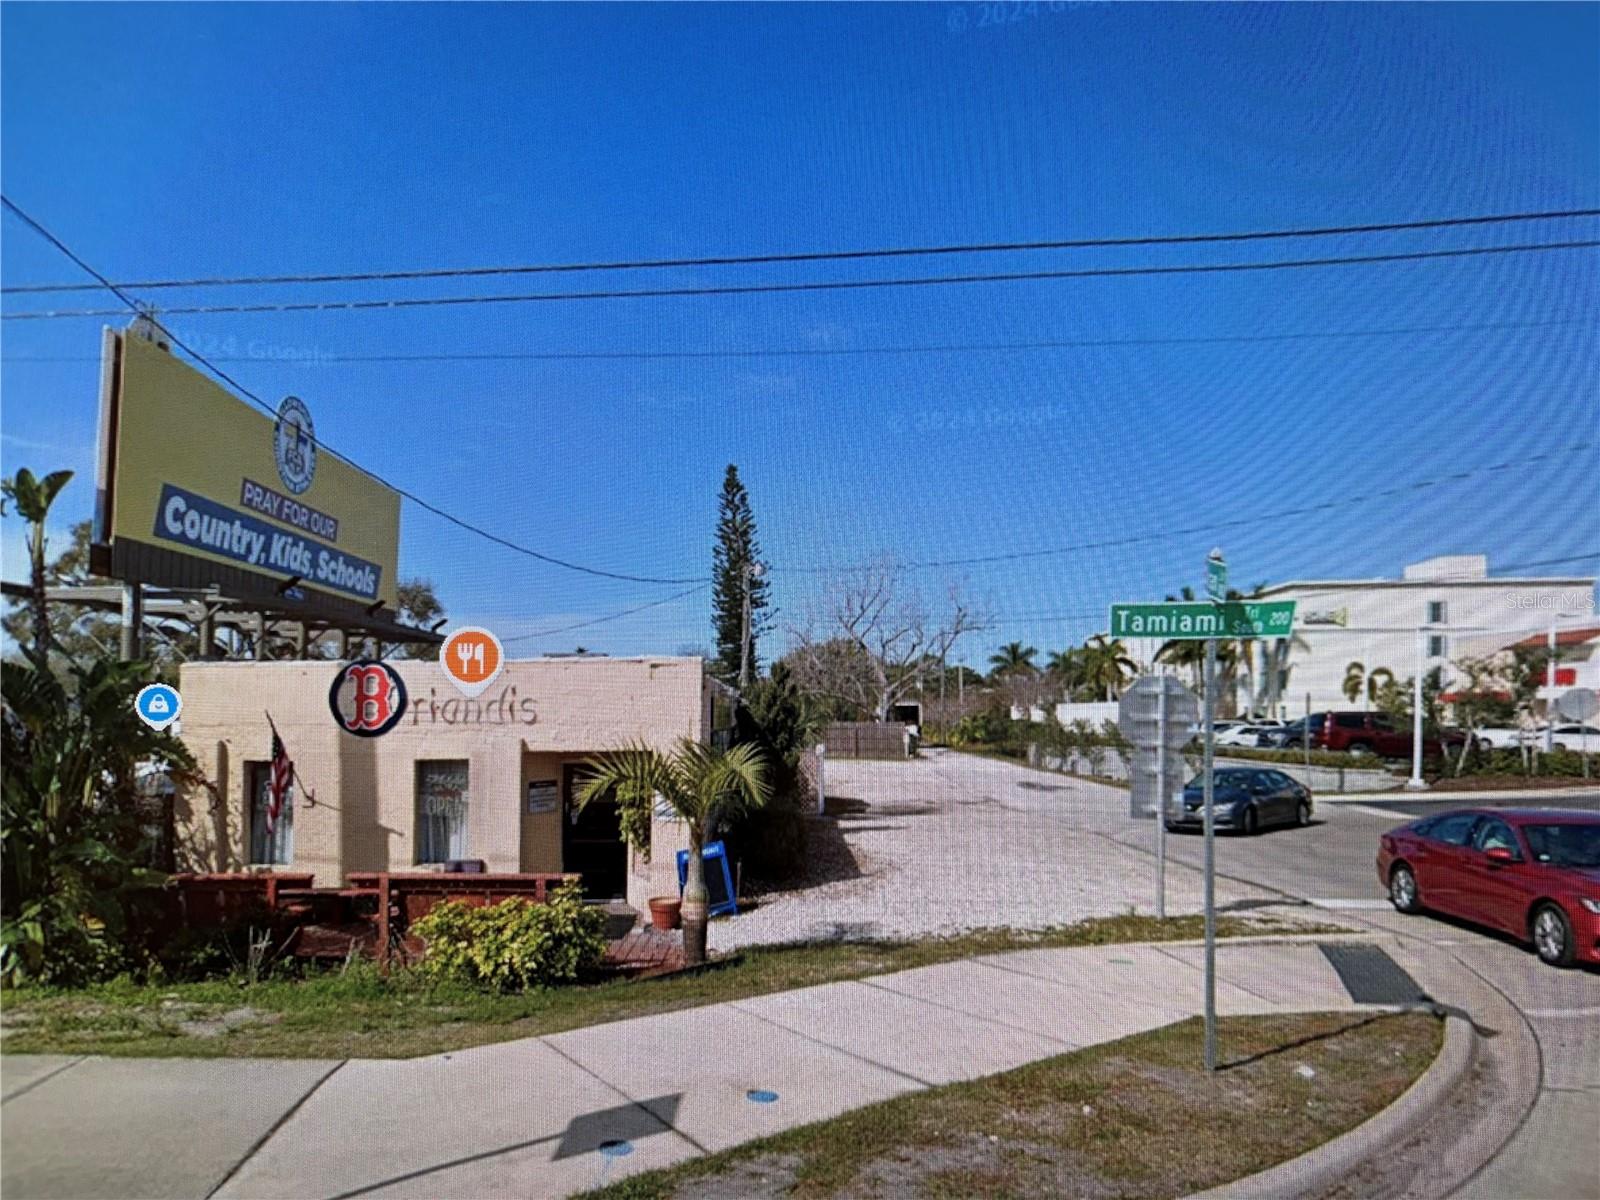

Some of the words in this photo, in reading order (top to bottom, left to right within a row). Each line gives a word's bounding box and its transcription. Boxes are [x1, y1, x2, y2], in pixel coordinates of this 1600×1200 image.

[243, 482, 281, 515] PRAY
[282, 497, 309, 529] FOR
[310, 512, 337, 539] OUR
[164, 495, 265, 565] Country,
[268, 532, 314, 580] Kids,
[316, 550, 376, 595] Schools
[1116, 609, 1225, 634] Tamiami
[1269, 611, 1291, 627] 200
